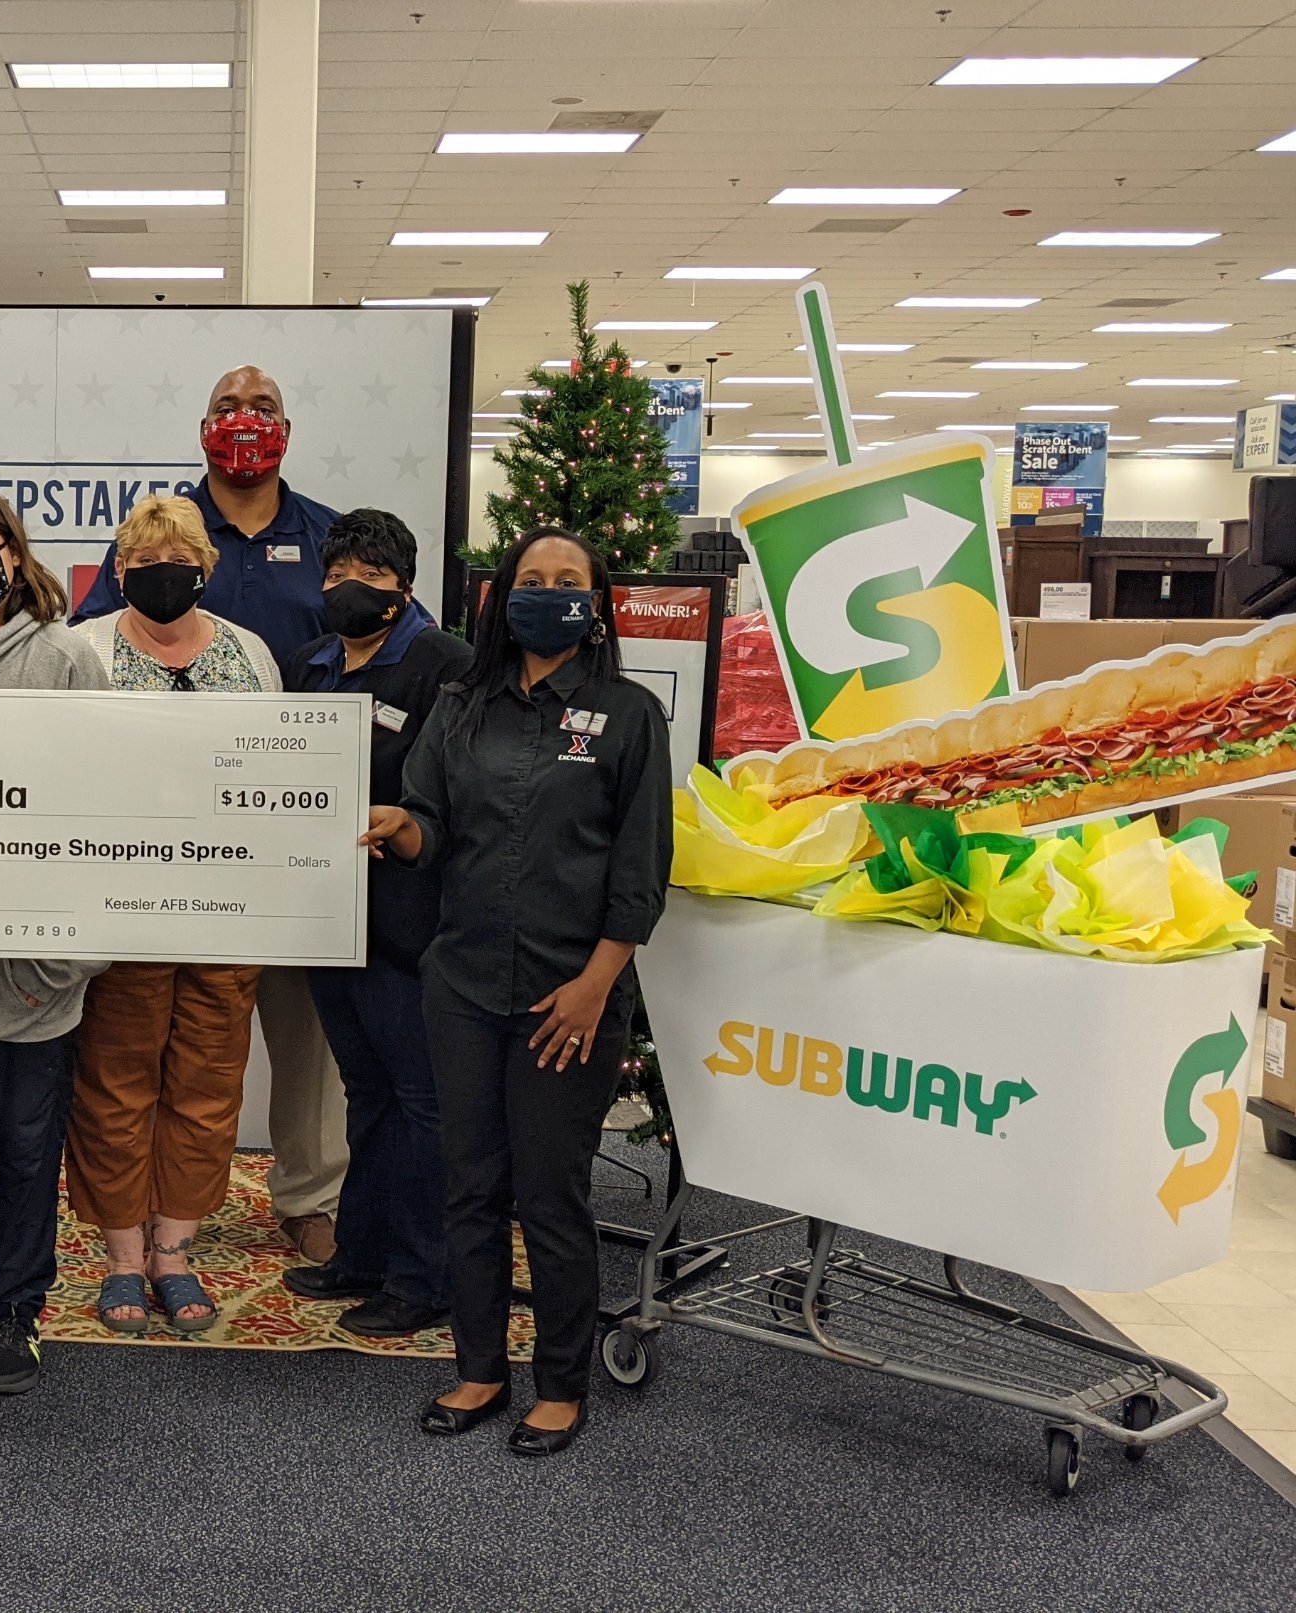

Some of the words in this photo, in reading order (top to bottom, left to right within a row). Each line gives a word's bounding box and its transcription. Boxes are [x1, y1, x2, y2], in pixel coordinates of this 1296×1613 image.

[647, 406, 655, 415] &
[658, 406, 685, 415] Dent
[1023, 437, 1051, 446] Phase
[1053, 437, 1071, 446] Out
[1022, 445, 1058, 454] Scratch
[1059, 445, 1066, 454] &
[1068, 445, 1093, 454] Dent
[1246, 443, 1270, 456] EXPERT
[1021, 454, 1058, 469] Sale
[631, 603, 690, 618] WINNER!
[280, 711, 339, 724] 01234
[234, 737, 307, 751] 11/21/2020
[214, 756, 243, 768] Date
[558, 754, 597, 763] EXCHANGE
[221, 789, 329, 811] $10,000
[68, 840, 174, 862] Shopping
[181, 841, 255, 862] Spree.
[288, 856, 331, 868] Dollars
[104, 896, 157, 910] Keesler
[160, 898, 188, 911] AFB
[191, 899, 247, 914] Subway
[702, 1020, 1039, 1137] SUBWAY
